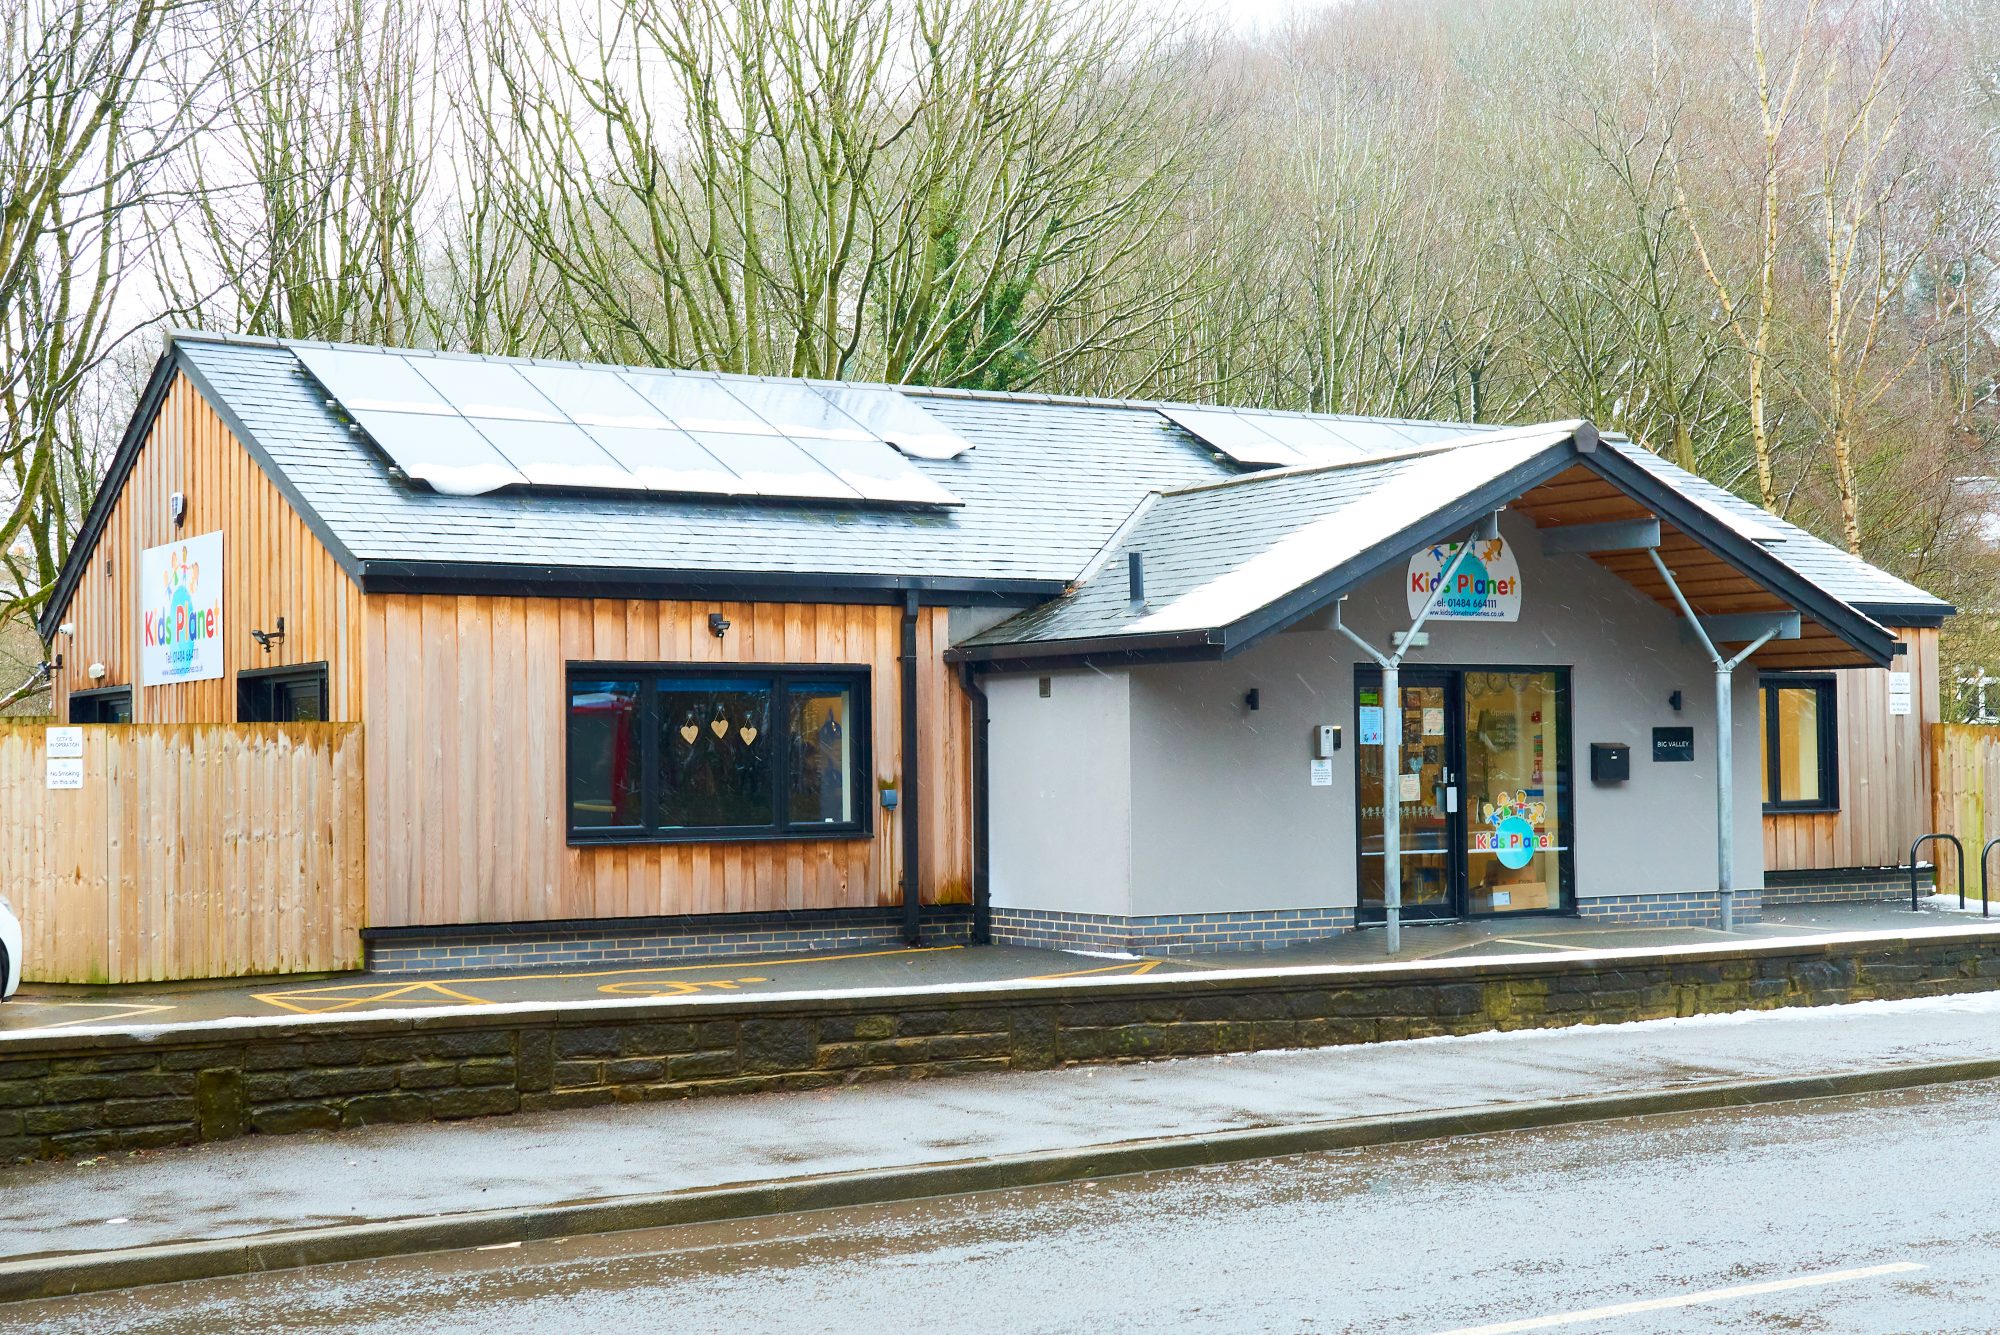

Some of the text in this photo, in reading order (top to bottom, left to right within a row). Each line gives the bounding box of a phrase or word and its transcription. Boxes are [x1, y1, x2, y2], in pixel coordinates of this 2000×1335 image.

[1458, 574, 1516, 595] Planet
[1433, 597, 1497, 609] el: 01484 664111
[146, 598, 219, 647] Kids Planet
[1668, 740, 1690, 748] VALLEY
[1475, 832, 1554, 850] Kids Planet
